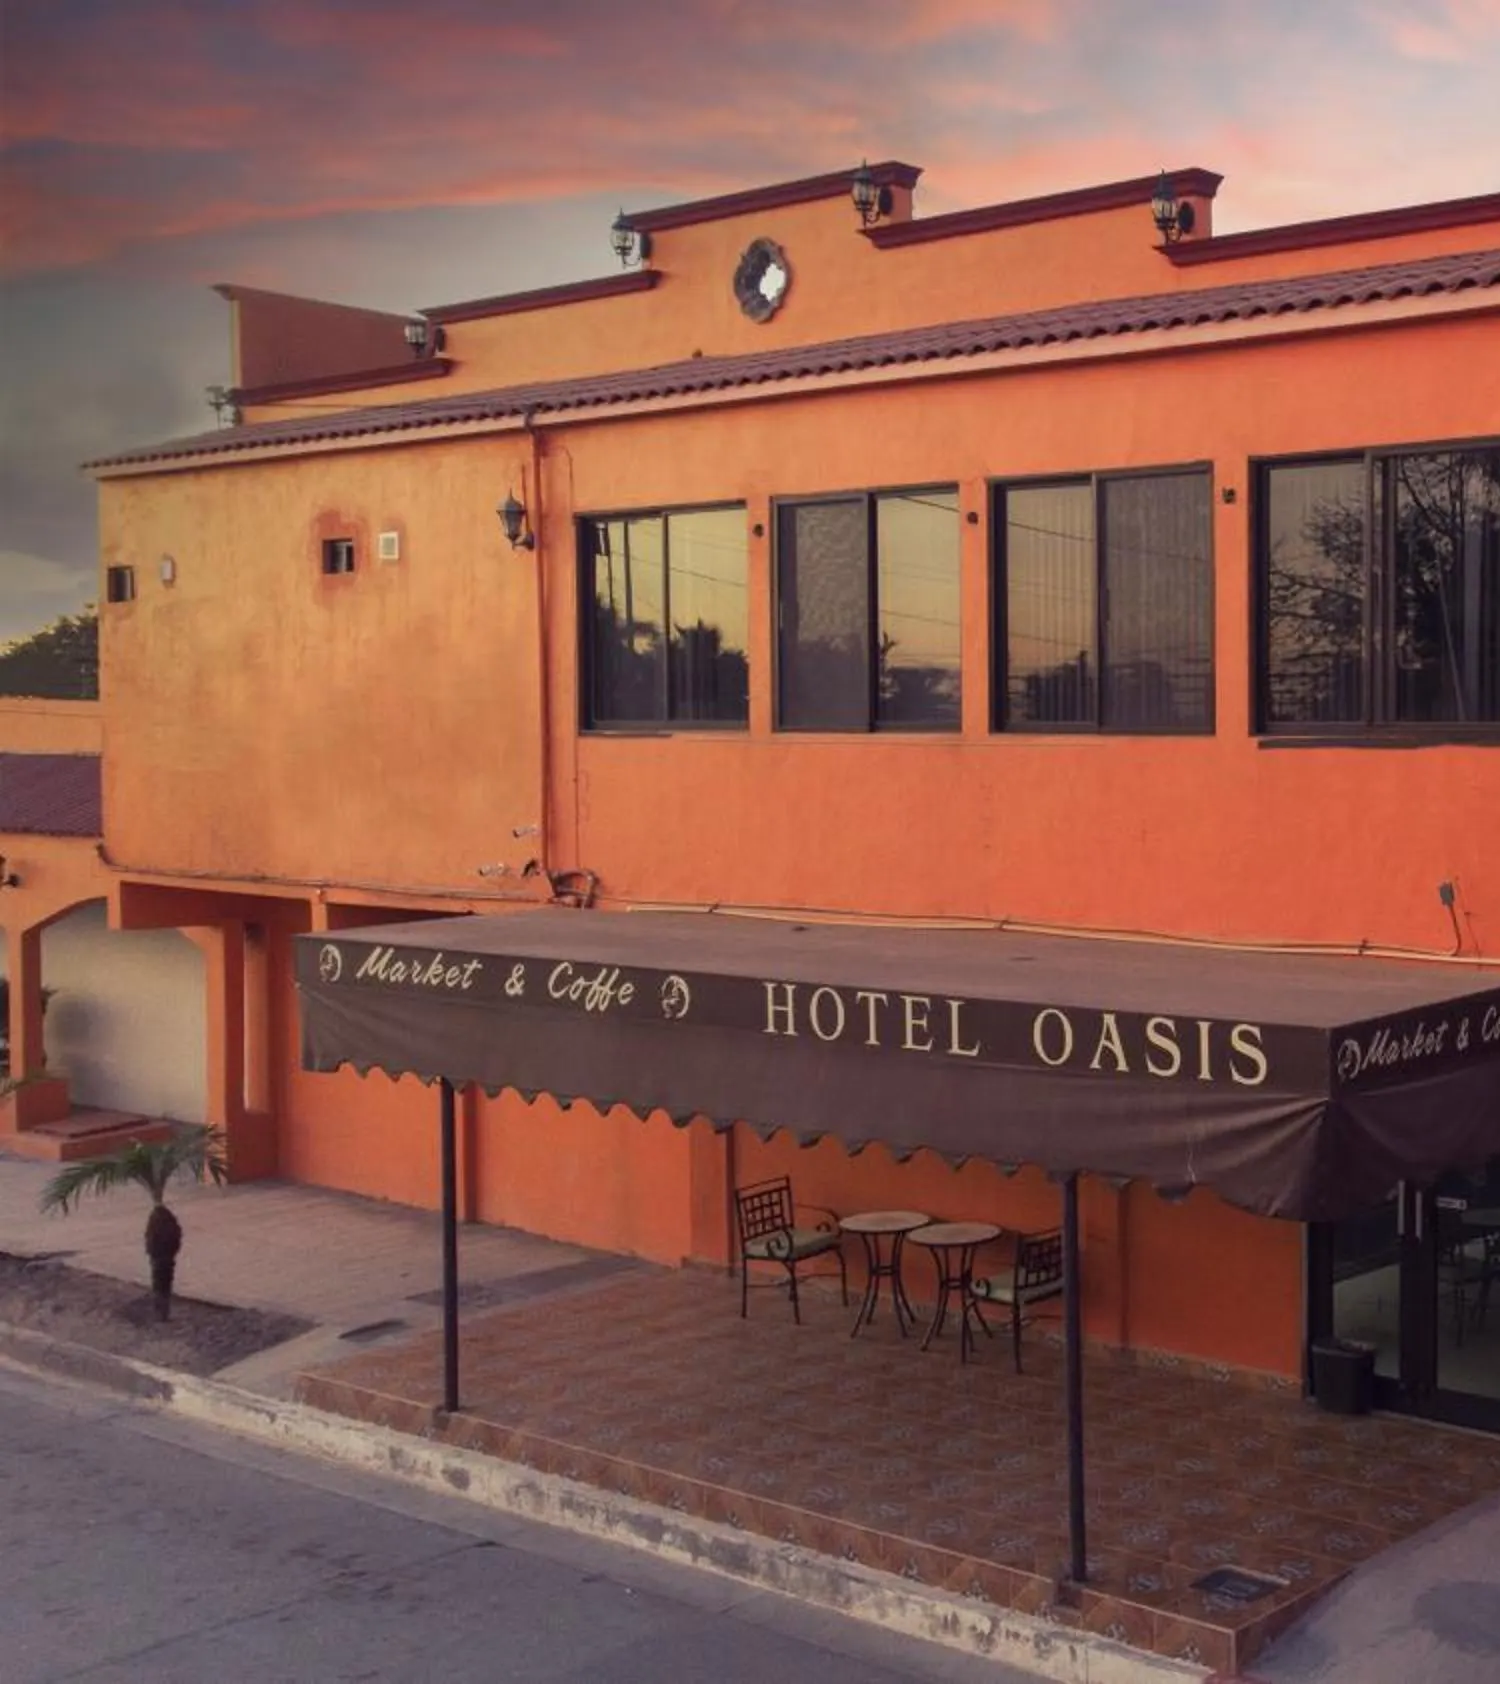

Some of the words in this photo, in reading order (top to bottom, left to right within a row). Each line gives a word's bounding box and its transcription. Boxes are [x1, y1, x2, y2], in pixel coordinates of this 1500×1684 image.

[355, 945, 483, 989] Market
[504, 963, 525, 996] &
[547, 961, 635, 1011] Coffe
[763, 982, 981, 1057] HOTEL
[1033, 1009, 1269, 1085] OASIS
[1362, 1020, 1450, 1070] Market
[1457, 1017, 1471, 1050] &
